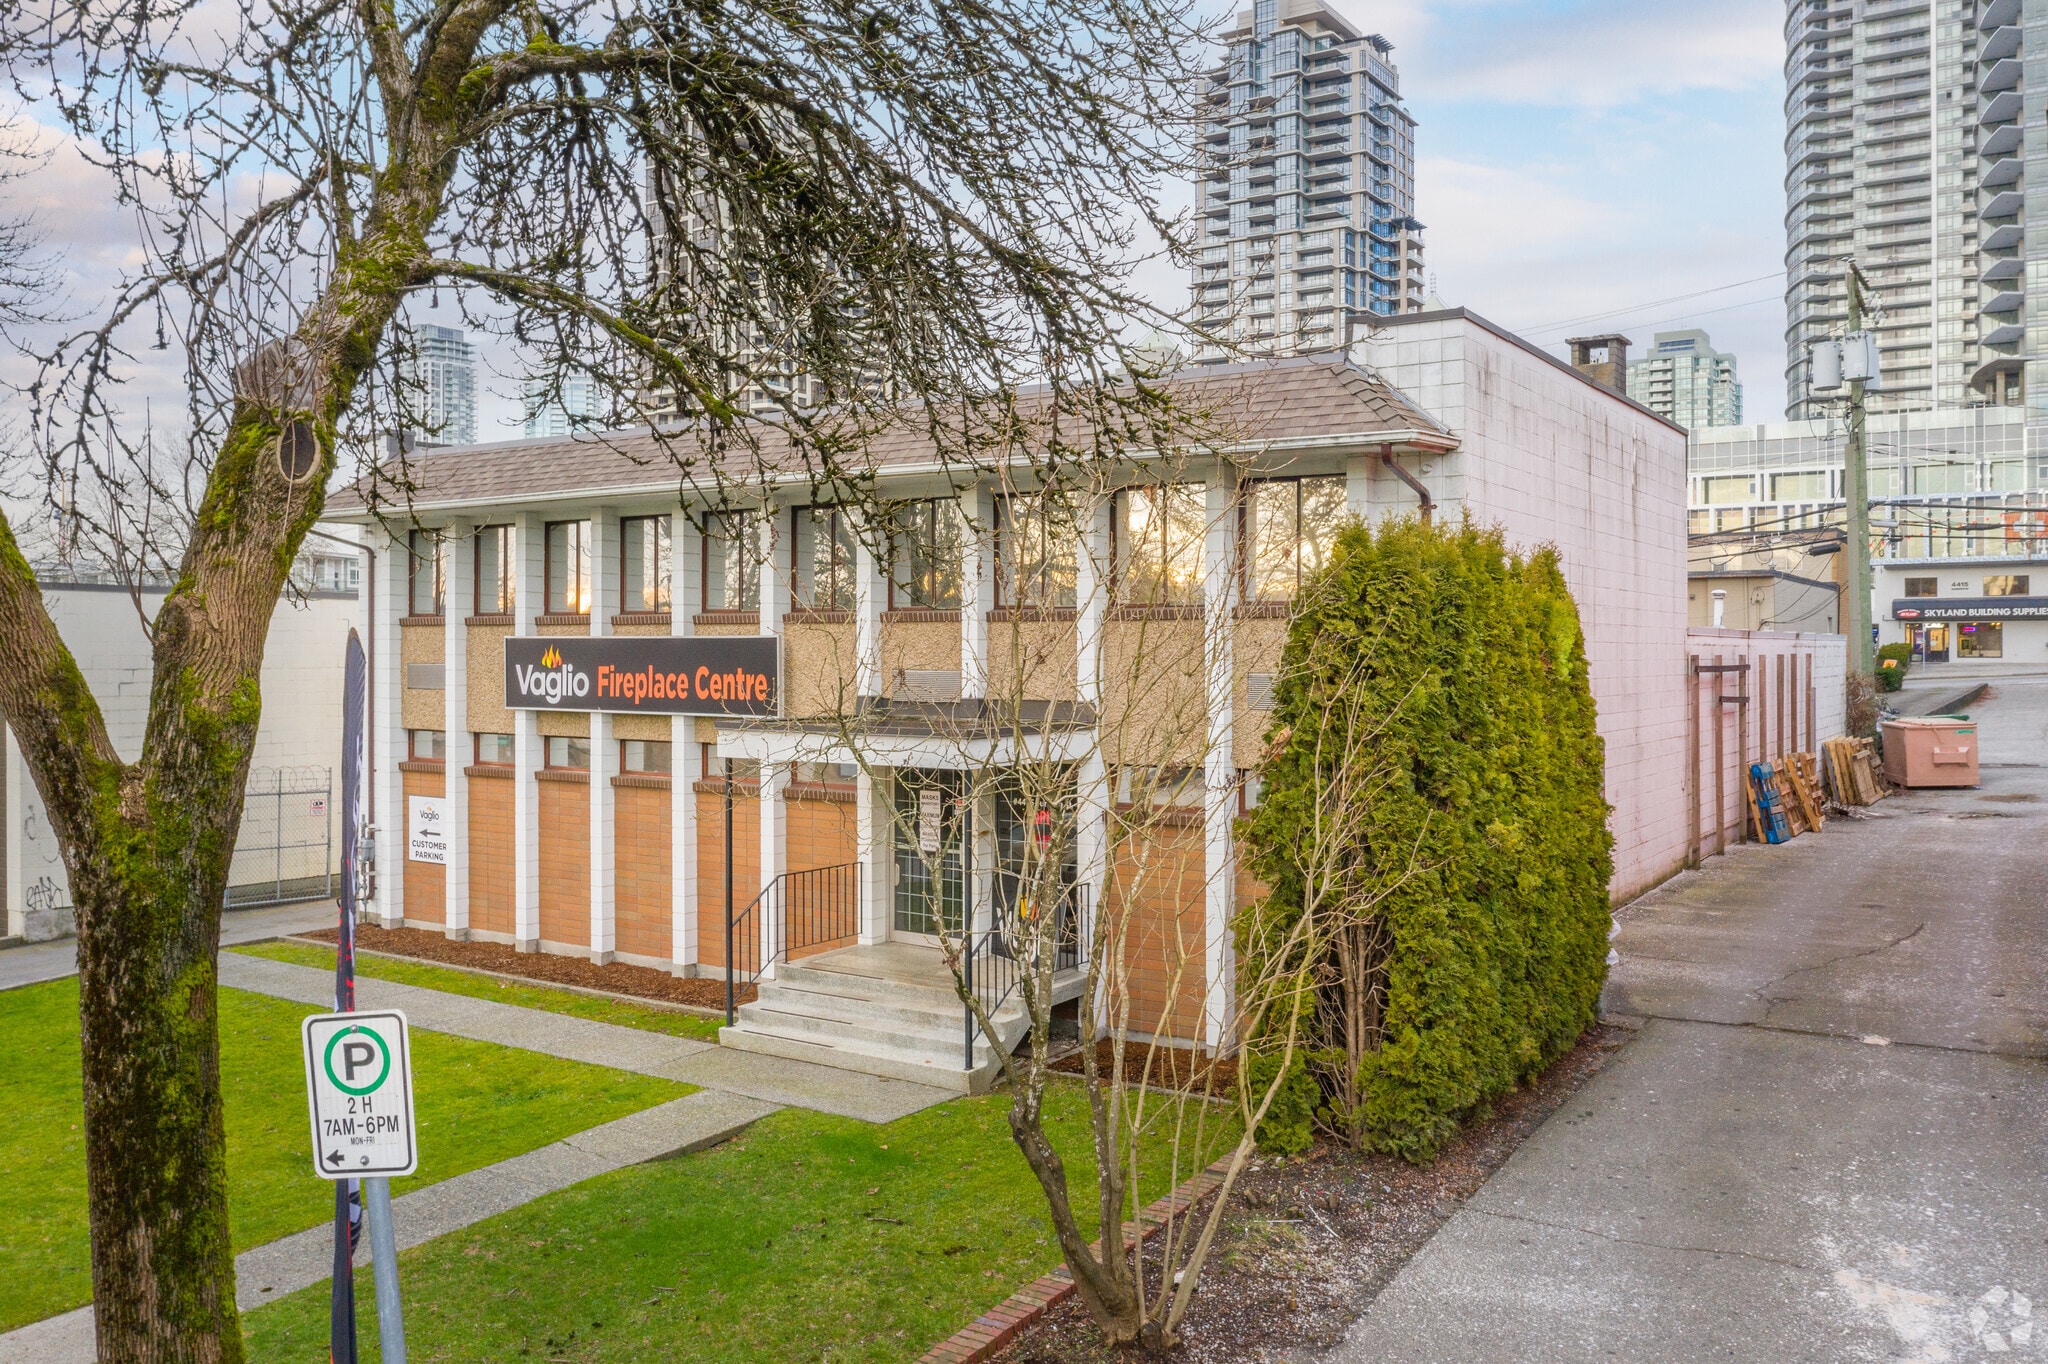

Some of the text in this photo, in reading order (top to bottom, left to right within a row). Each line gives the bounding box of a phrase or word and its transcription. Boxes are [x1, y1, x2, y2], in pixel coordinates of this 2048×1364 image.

[1924, 609, 1967, 617] SKYLAND
[1968, 608, 2011, 616] BUILDING
[515, 663, 768, 705] Vaglio Fireplace Centre
[419, 810, 440, 821] Vaglio
[412, 839, 447, 850] CUSTOMER
[415, 850, 444, 861] PARKING
[343, 1042, 375, 1080] P
[347, 1096, 373, 1114] 2 H
[324, 1115, 399, 1136] 7AM-6PM
[350, 1136, 375, 1145] MON-FRI
